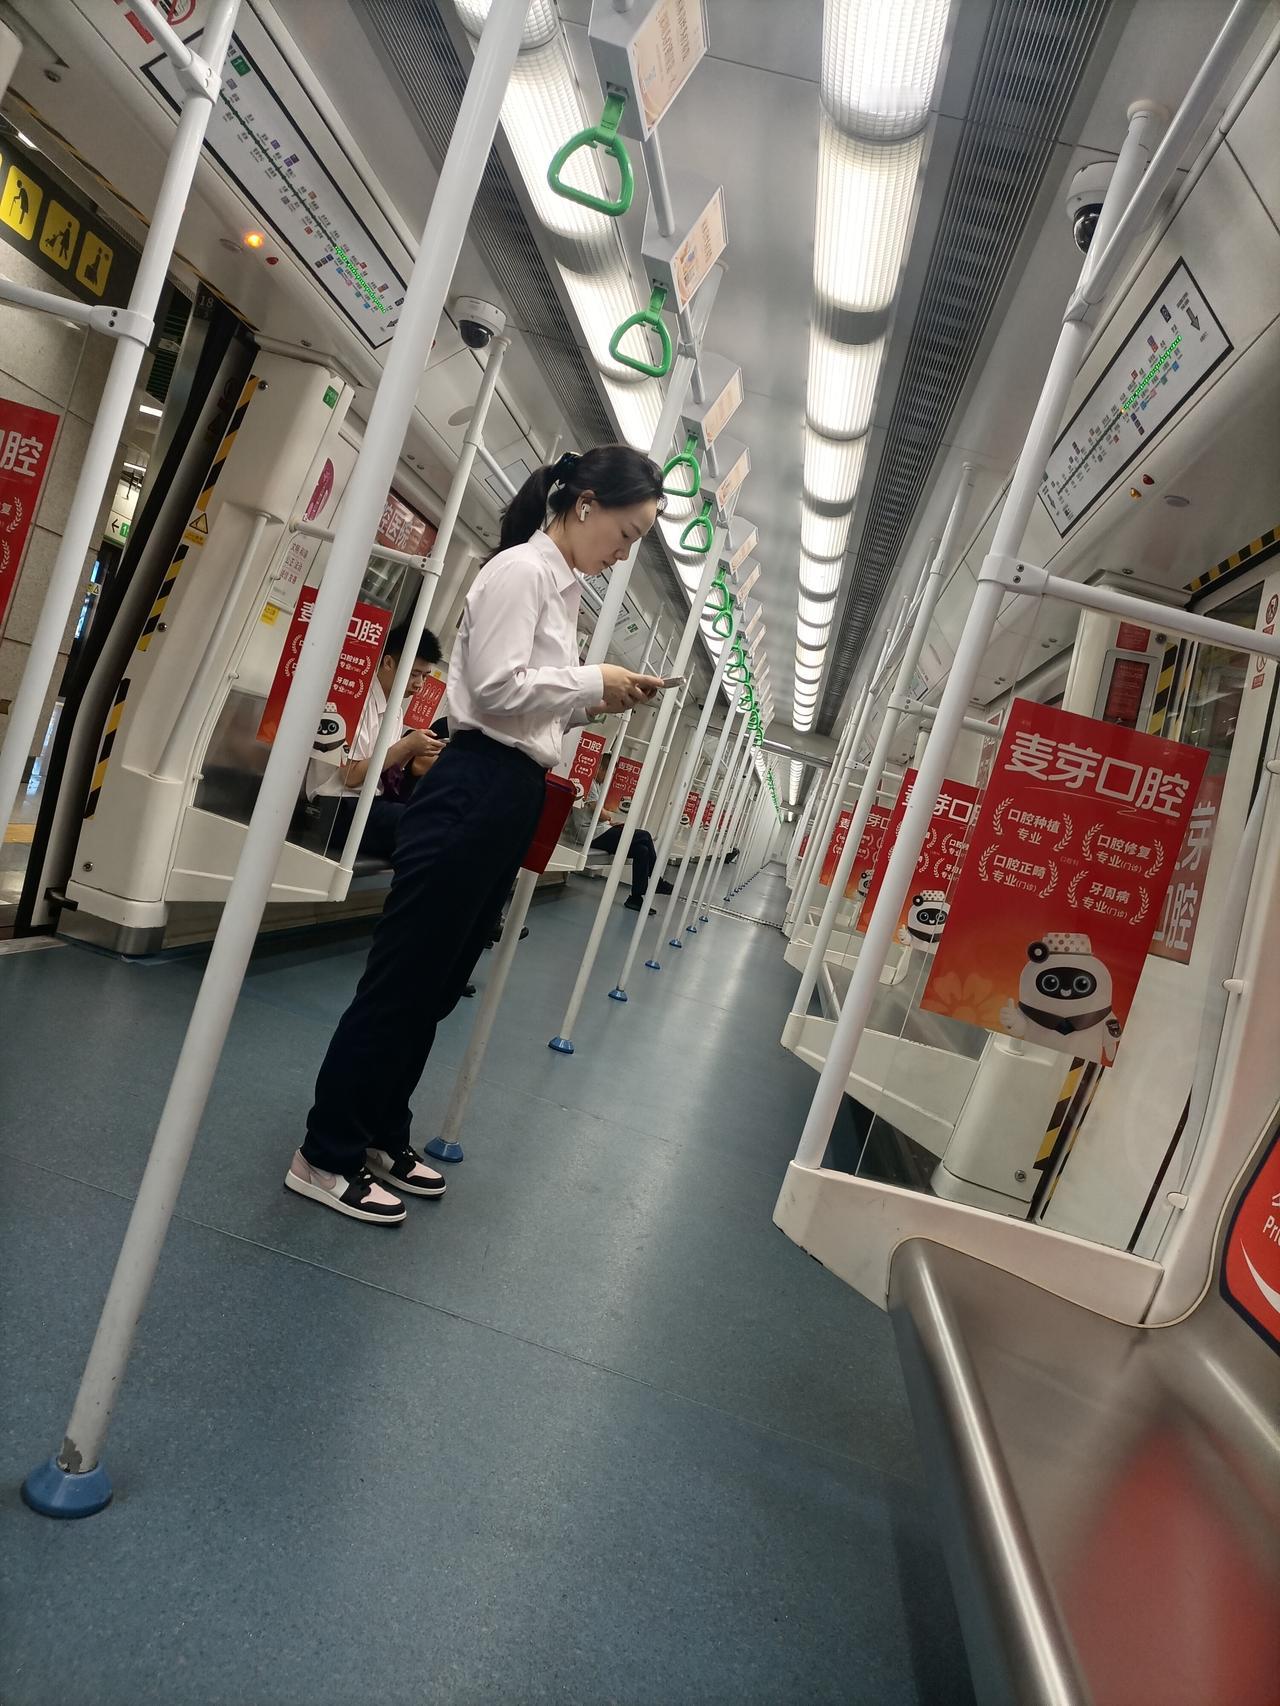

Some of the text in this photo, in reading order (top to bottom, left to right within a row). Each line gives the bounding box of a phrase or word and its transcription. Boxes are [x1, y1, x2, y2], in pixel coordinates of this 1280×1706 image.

[0, 429, 43, 477] 腔
[579, 737, 602, 754] 口腔
[1004, 730, 1190, 818] 麦芽口腔
[1007, 809, 1061, 834] 口腔种植
[1017, 827, 1043, 846] 专业
[1097, 834, 1152, 860] 口腔修复
[993, 854, 1047, 880] 口腔正畸
[1089, 881, 1131, 905] 牙周病
[1262, 1216, 1280, 1246] Pri
